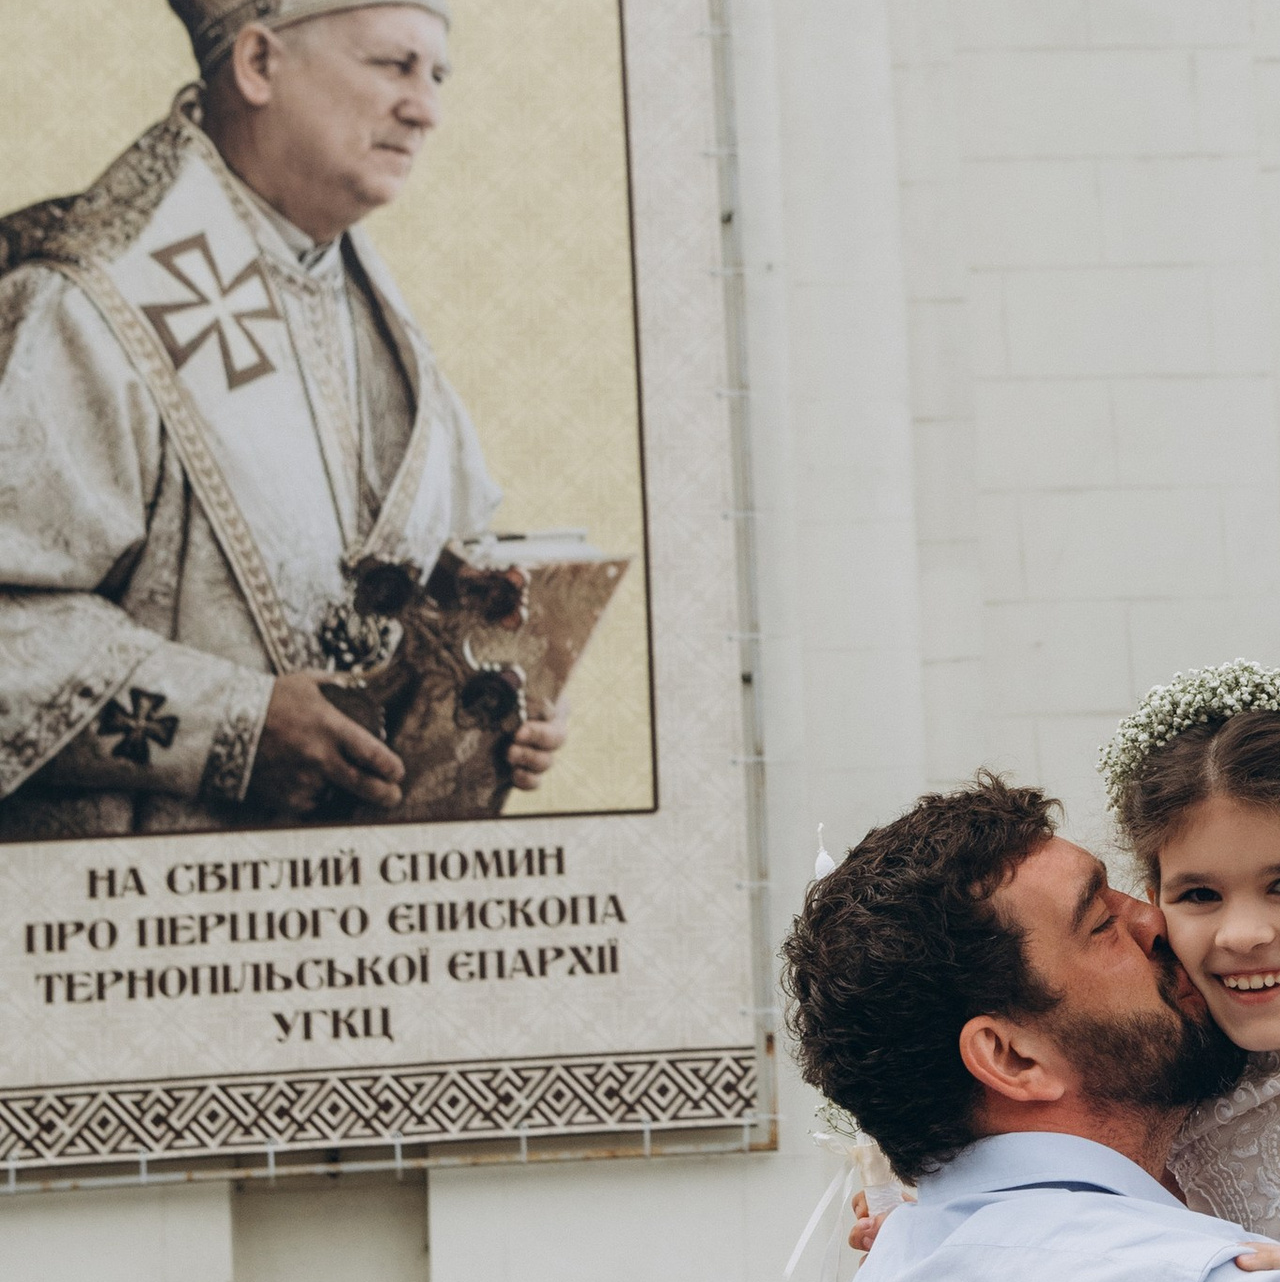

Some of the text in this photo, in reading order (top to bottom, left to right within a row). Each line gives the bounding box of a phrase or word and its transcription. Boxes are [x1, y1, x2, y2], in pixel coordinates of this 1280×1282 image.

[86, 845, 567, 901] НА СВІТЛИЙ СПОМИН
[25, 893, 628, 956] ПРО ПЕРШОГО ЄПИСКОПА
[34, 939, 621, 1004] ТЕРНОПІЛЬСЬКОЇ ЄПАРХІЇ
[272, 1005, 395, 1044] УГКЦ
